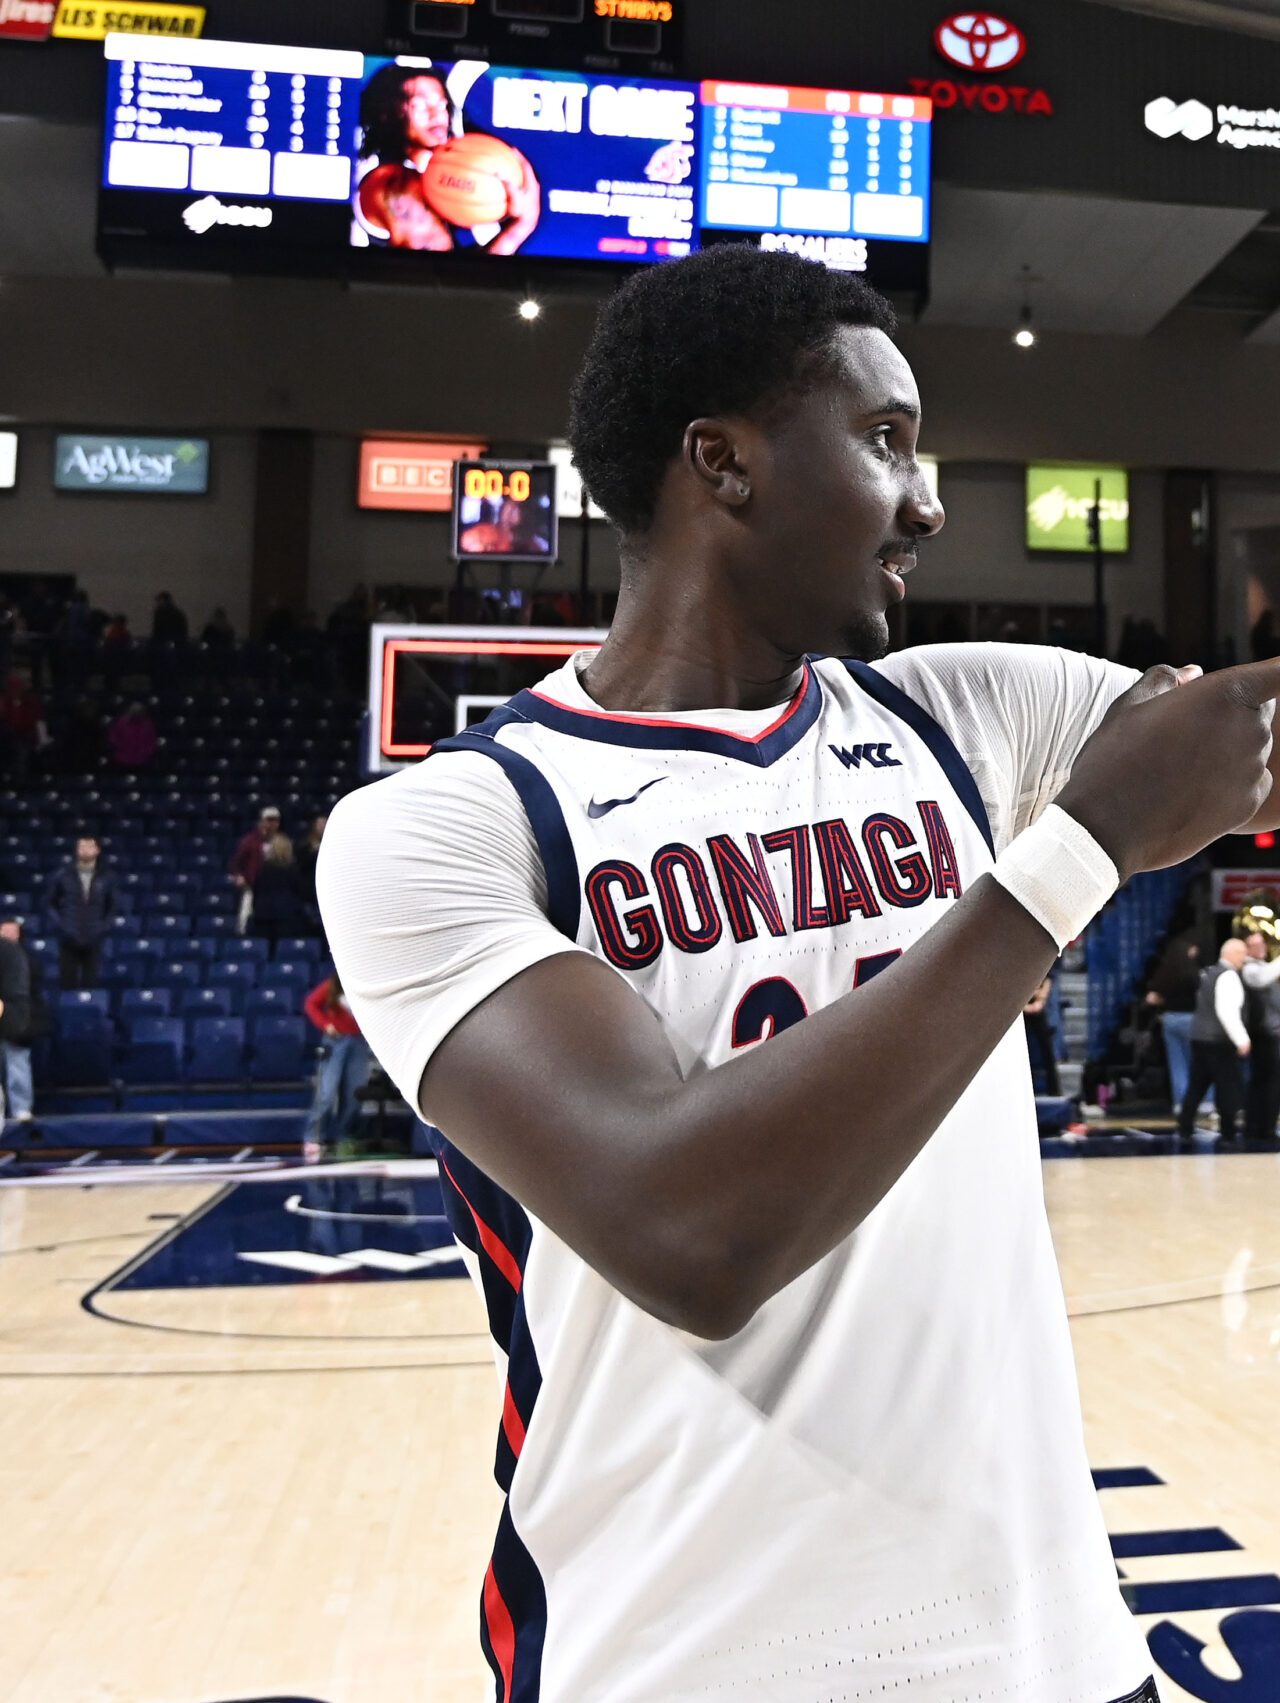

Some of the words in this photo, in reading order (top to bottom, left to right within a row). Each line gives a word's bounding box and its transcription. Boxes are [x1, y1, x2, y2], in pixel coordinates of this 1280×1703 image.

[62, 9, 95, 26] LES
[103, 12, 196, 34] SCHWAB
[908, 79, 1053, 116] TOYOTA
[380, 464, 446, 487] BEC
[828, 743, 903, 770] WCC
[584, 800, 964, 971] GONZAGA
